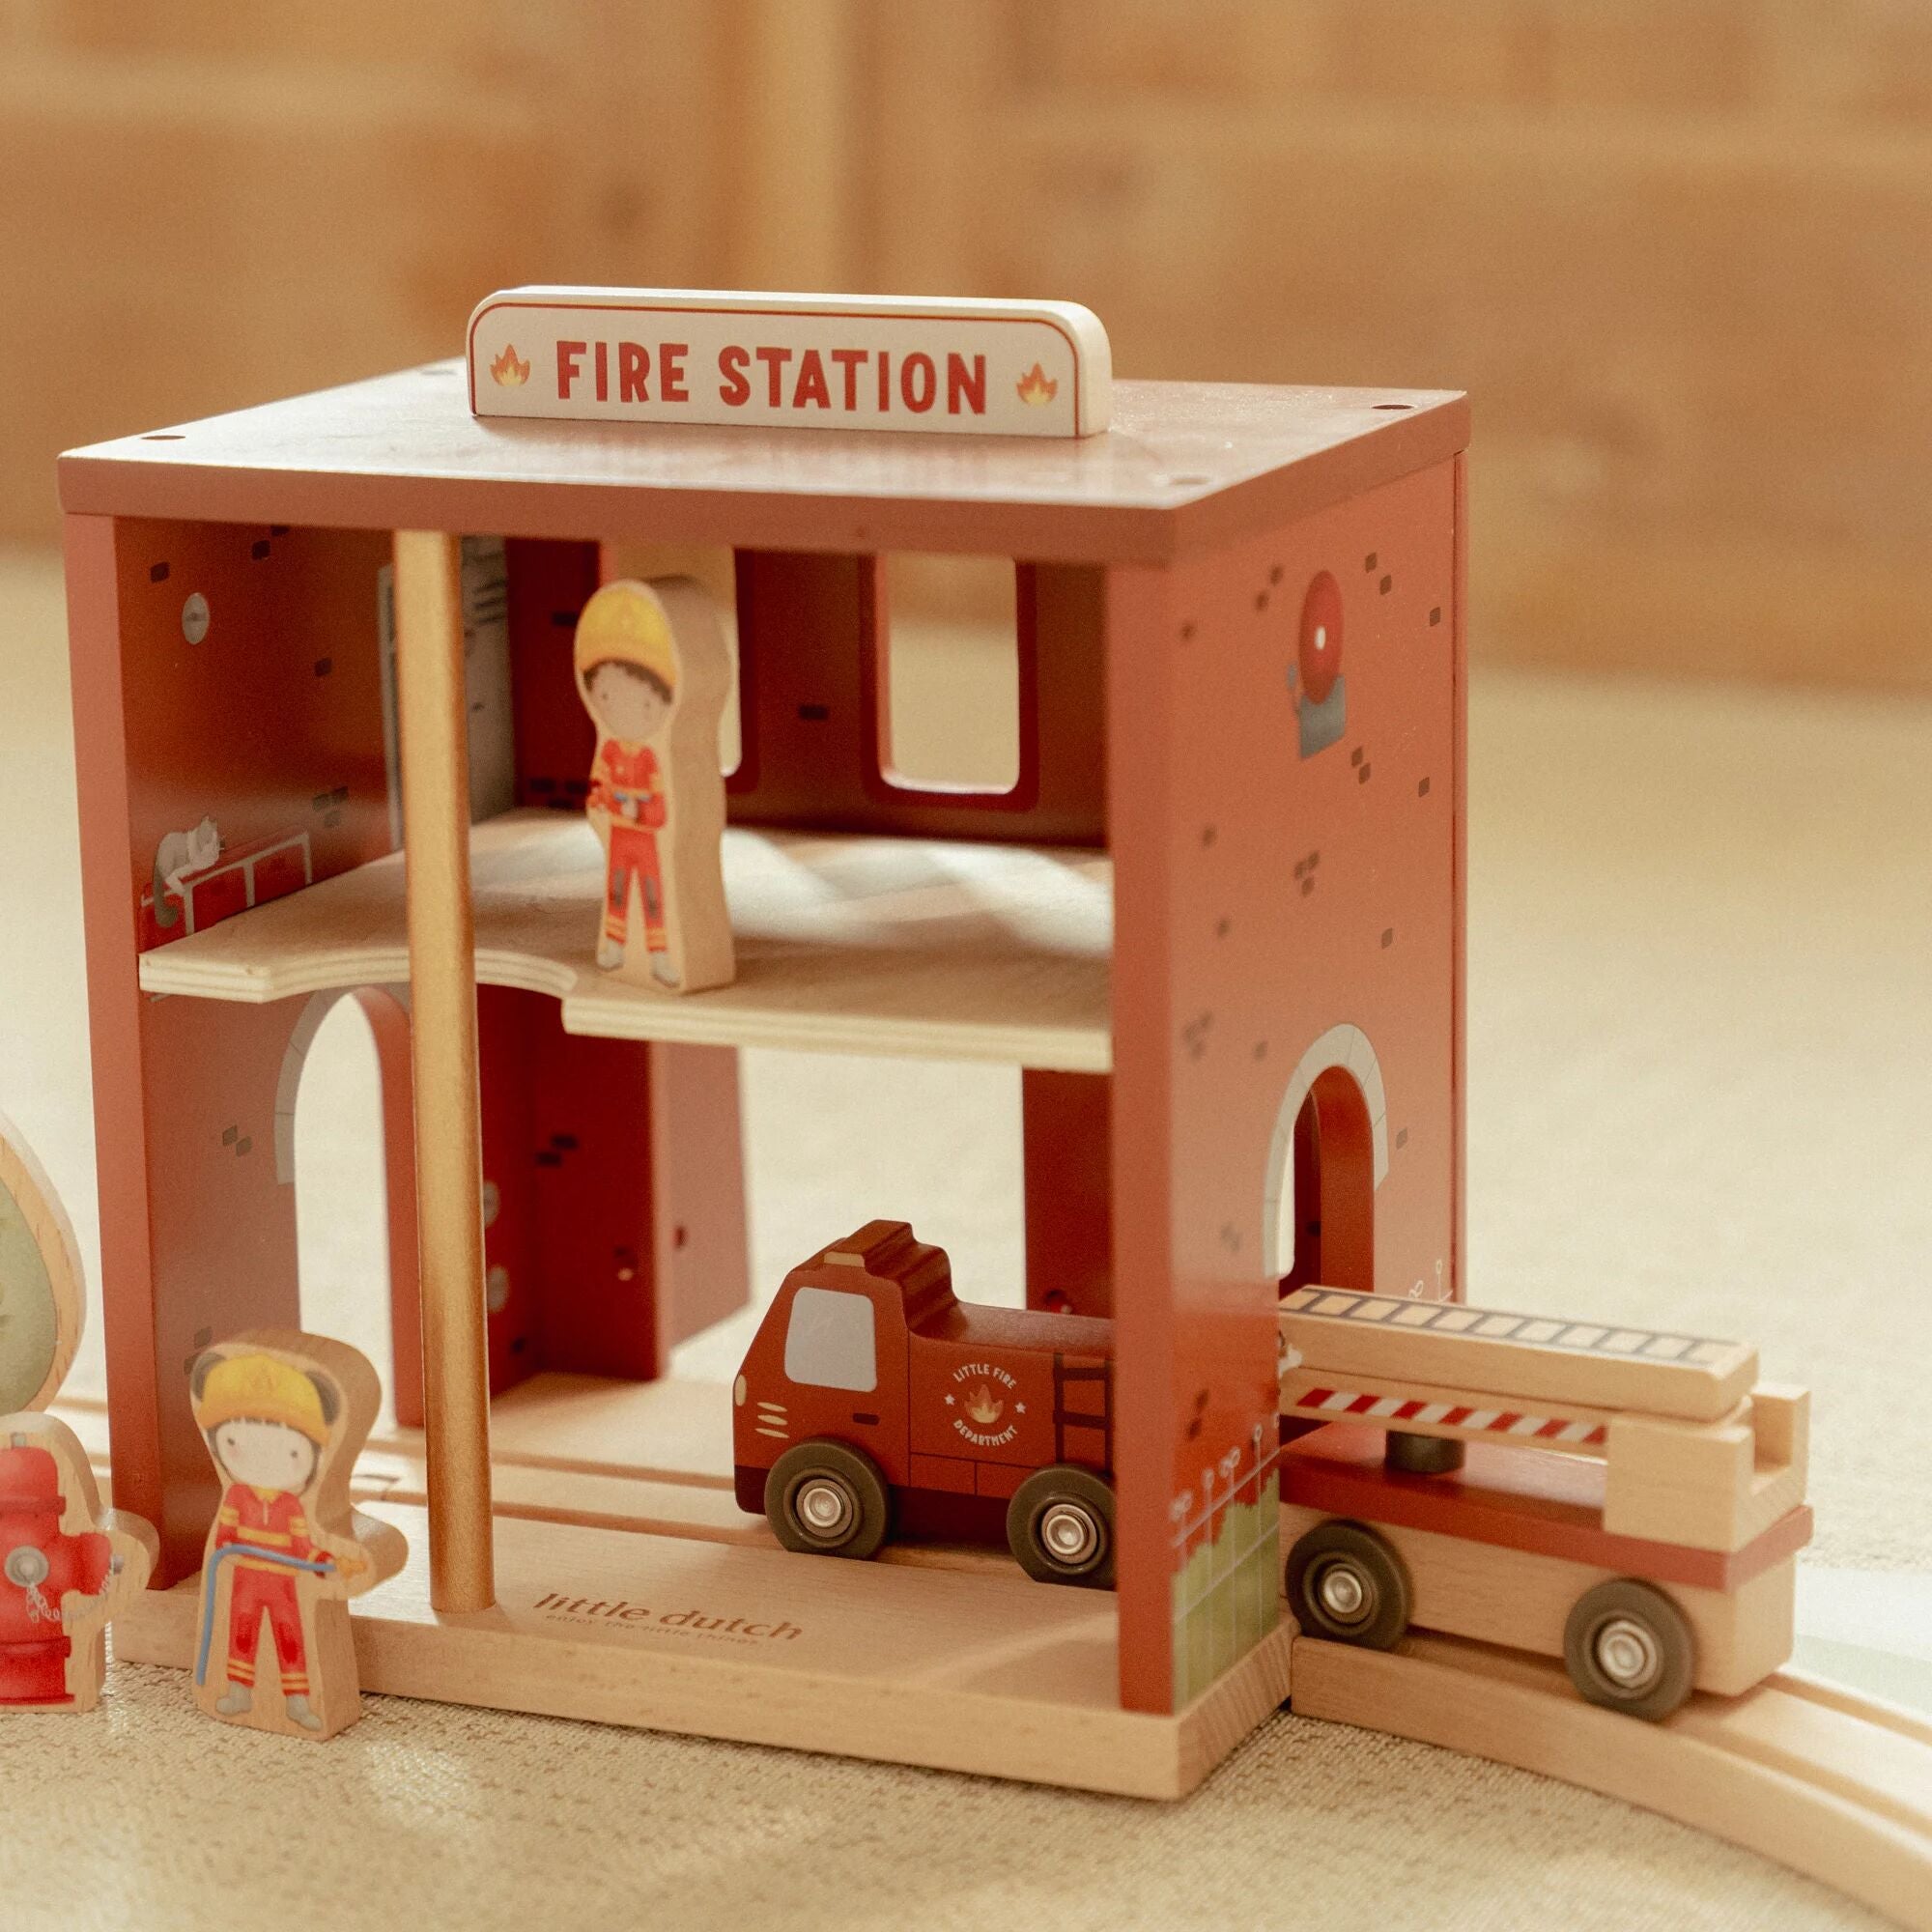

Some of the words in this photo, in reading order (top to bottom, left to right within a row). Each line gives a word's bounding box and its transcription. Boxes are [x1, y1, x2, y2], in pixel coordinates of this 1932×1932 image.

[556, 340, 689, 404] FIRE
[718, 345, 986, 414] STATION
[952, 1363, 990, 1382] LITTLE
[993, 1367, 1017, 1389] FIRE
[952, 1419, 1018, 1446] DEPARTMENT
[533, 1593, 651, 1621] little
[659, 1610, 803, 1639] dutch
